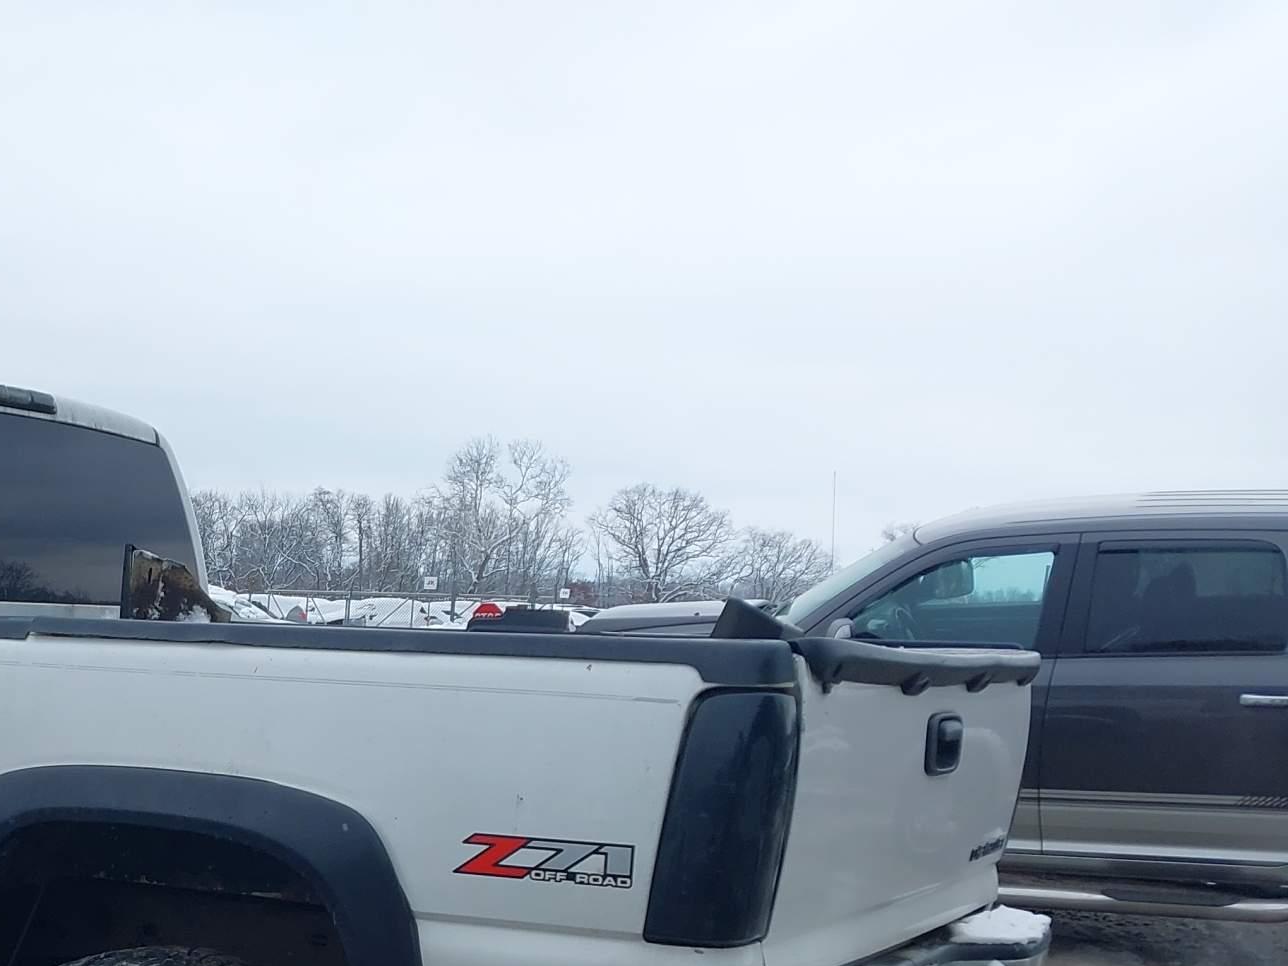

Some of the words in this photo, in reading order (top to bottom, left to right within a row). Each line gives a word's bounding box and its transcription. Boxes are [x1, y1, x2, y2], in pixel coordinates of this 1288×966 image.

[453, 832, 636, 879] Z71
[530, 870, 568, 883] OFF
[575, 871, 632, 888] ROAD
